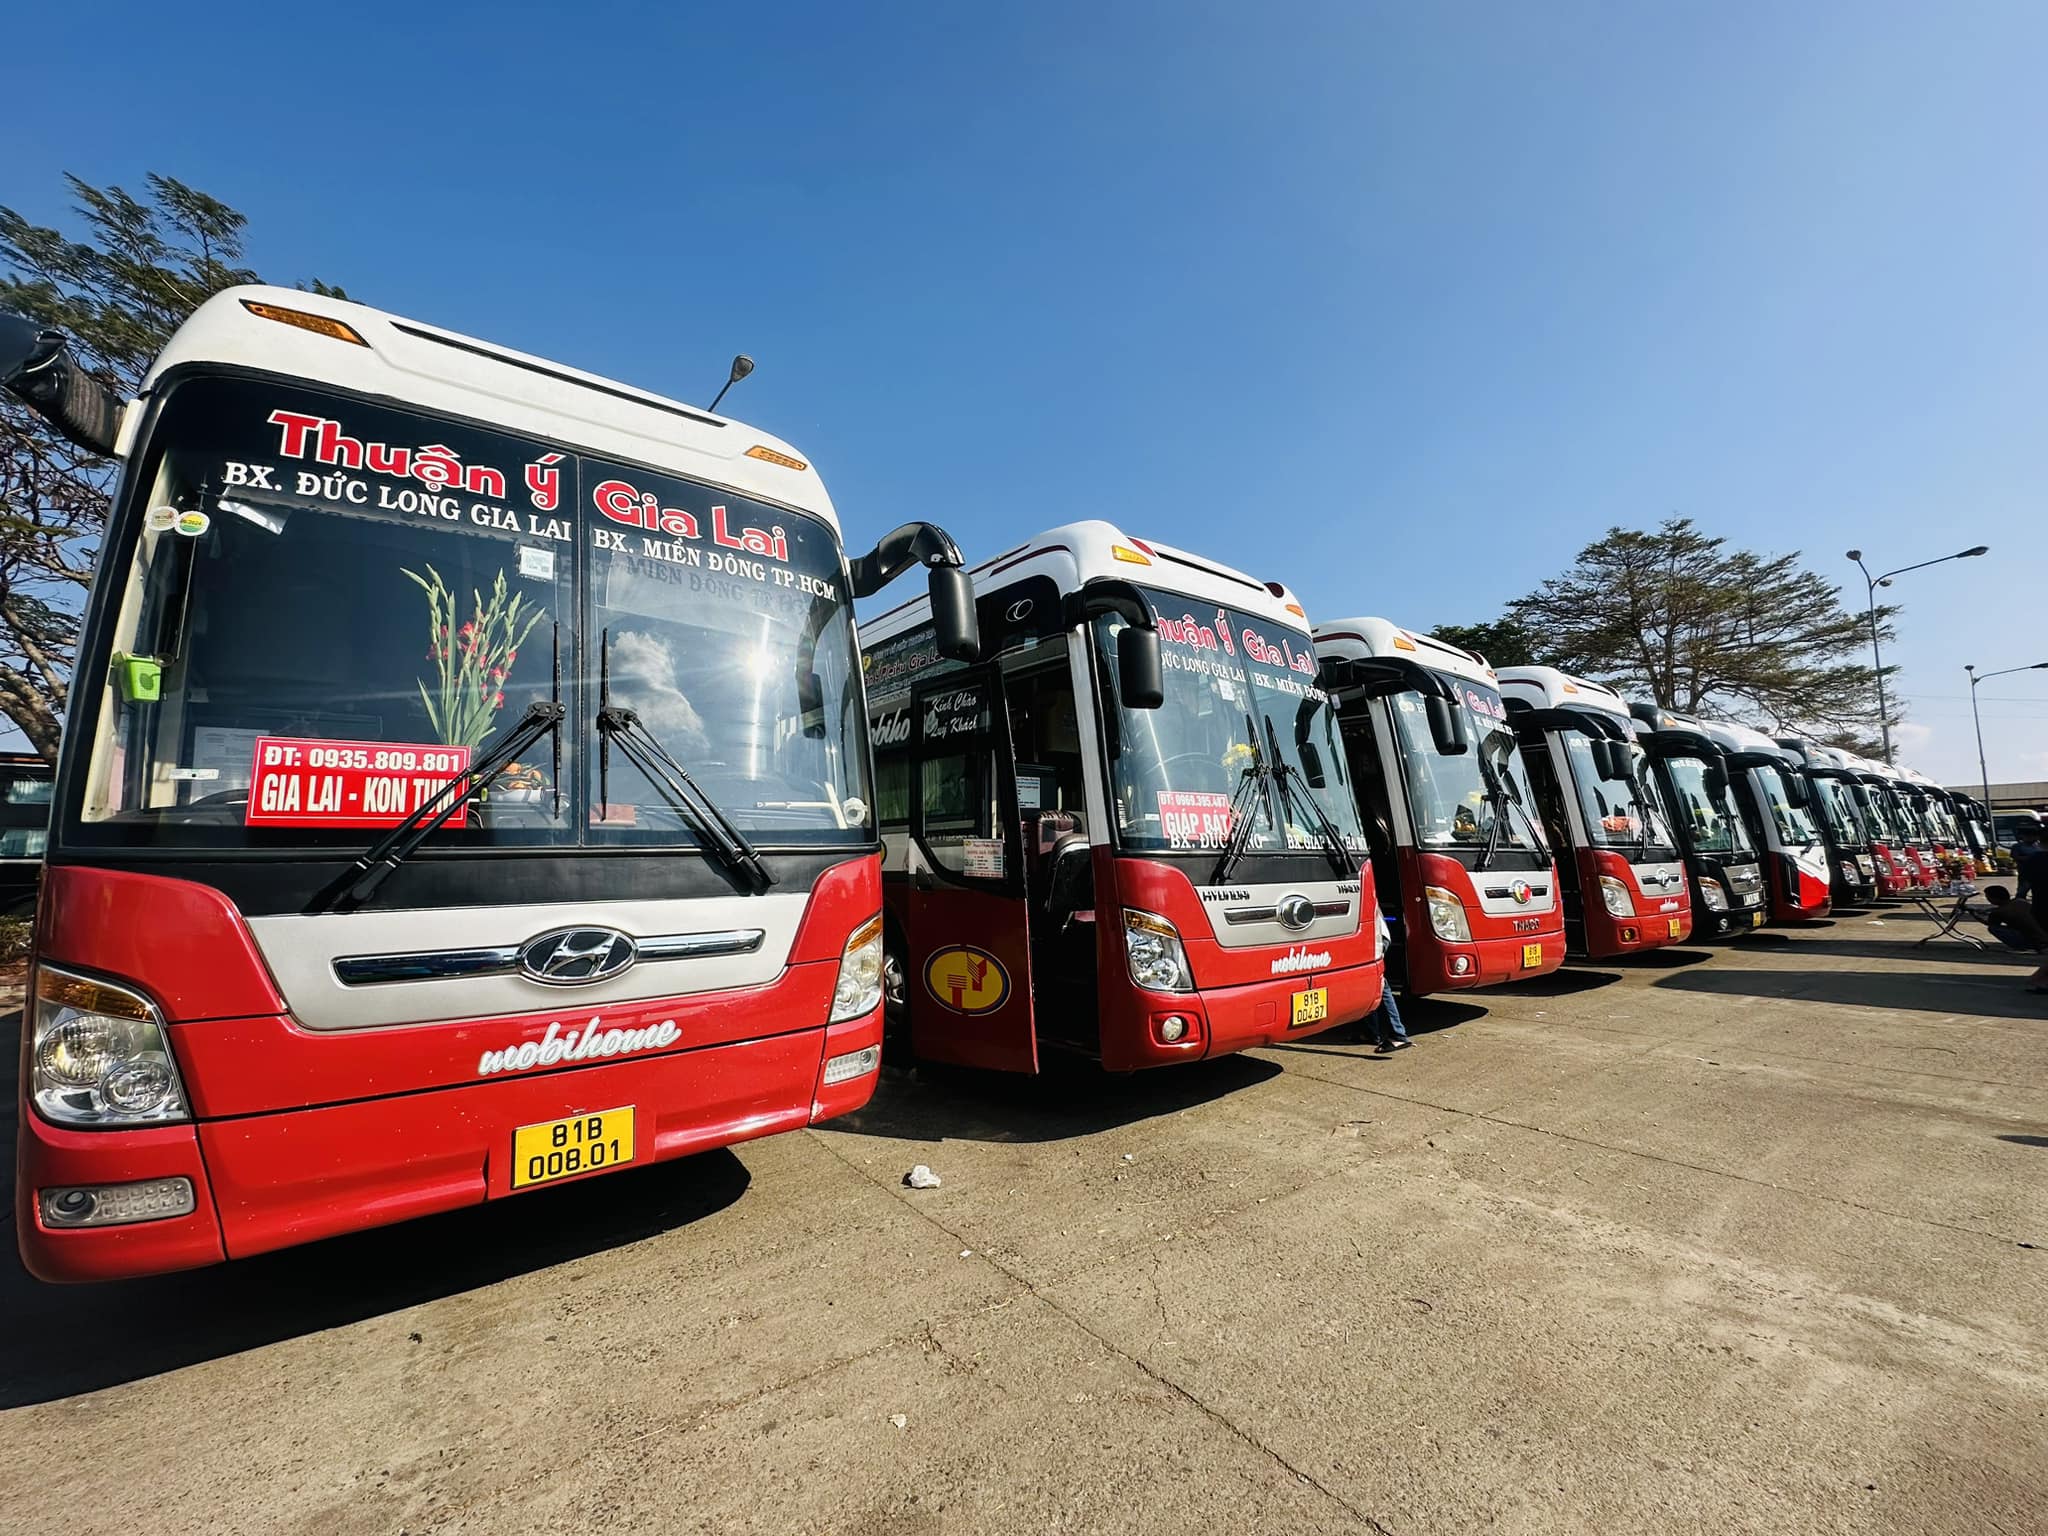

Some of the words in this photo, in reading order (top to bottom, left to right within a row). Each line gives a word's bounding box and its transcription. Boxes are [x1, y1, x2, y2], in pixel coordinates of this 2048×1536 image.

[267, 409, 506, 499] Thuận
[525, 453, 566, 511] ý
[223, 462, 283, 491] BX.
[296, 471, 368, 505] ĐỨC
[378, 486, 461, 521] LONG
[471, 504, 521, 532] GIA
[528, 514, 572, 542] LAI
[593, 479, 702, 540] Gia
[711, 505, 789, 562] Lai
[593, 528, 634, 554] BX.
[642, 537, 701, 567] MIỀN
[708, 552, 766, 582] ĐÔNG
[771, 567, 837, 602] TP.HCM
[1152, 605, 1218, 653] huận
[1242, 628, 1285, 667] Gia
[1282, 639, 1317, 677] Lai
[1182, 655, 1209, 675] LONG
[1211, 663, 1230, 680] GIA
[1231, 667, 1247, 683] LAI
[264, 746, 301, 767] ĐT:
[309, 748, 460, 772] 0935.809.801
[261, 773, 301, 812] GIA
[306, 775, 344, 813] LAI
[363, 777, 409, 813] KON
[1271, 945, 1332, 975] mobihome
[1304, 992, 1319, 1007] 81B
[478, 1016, 682, 1076] mobihome
[552, 1117, 602, 1147] 81B
[528, 1139, 620, 1180] 008.01
